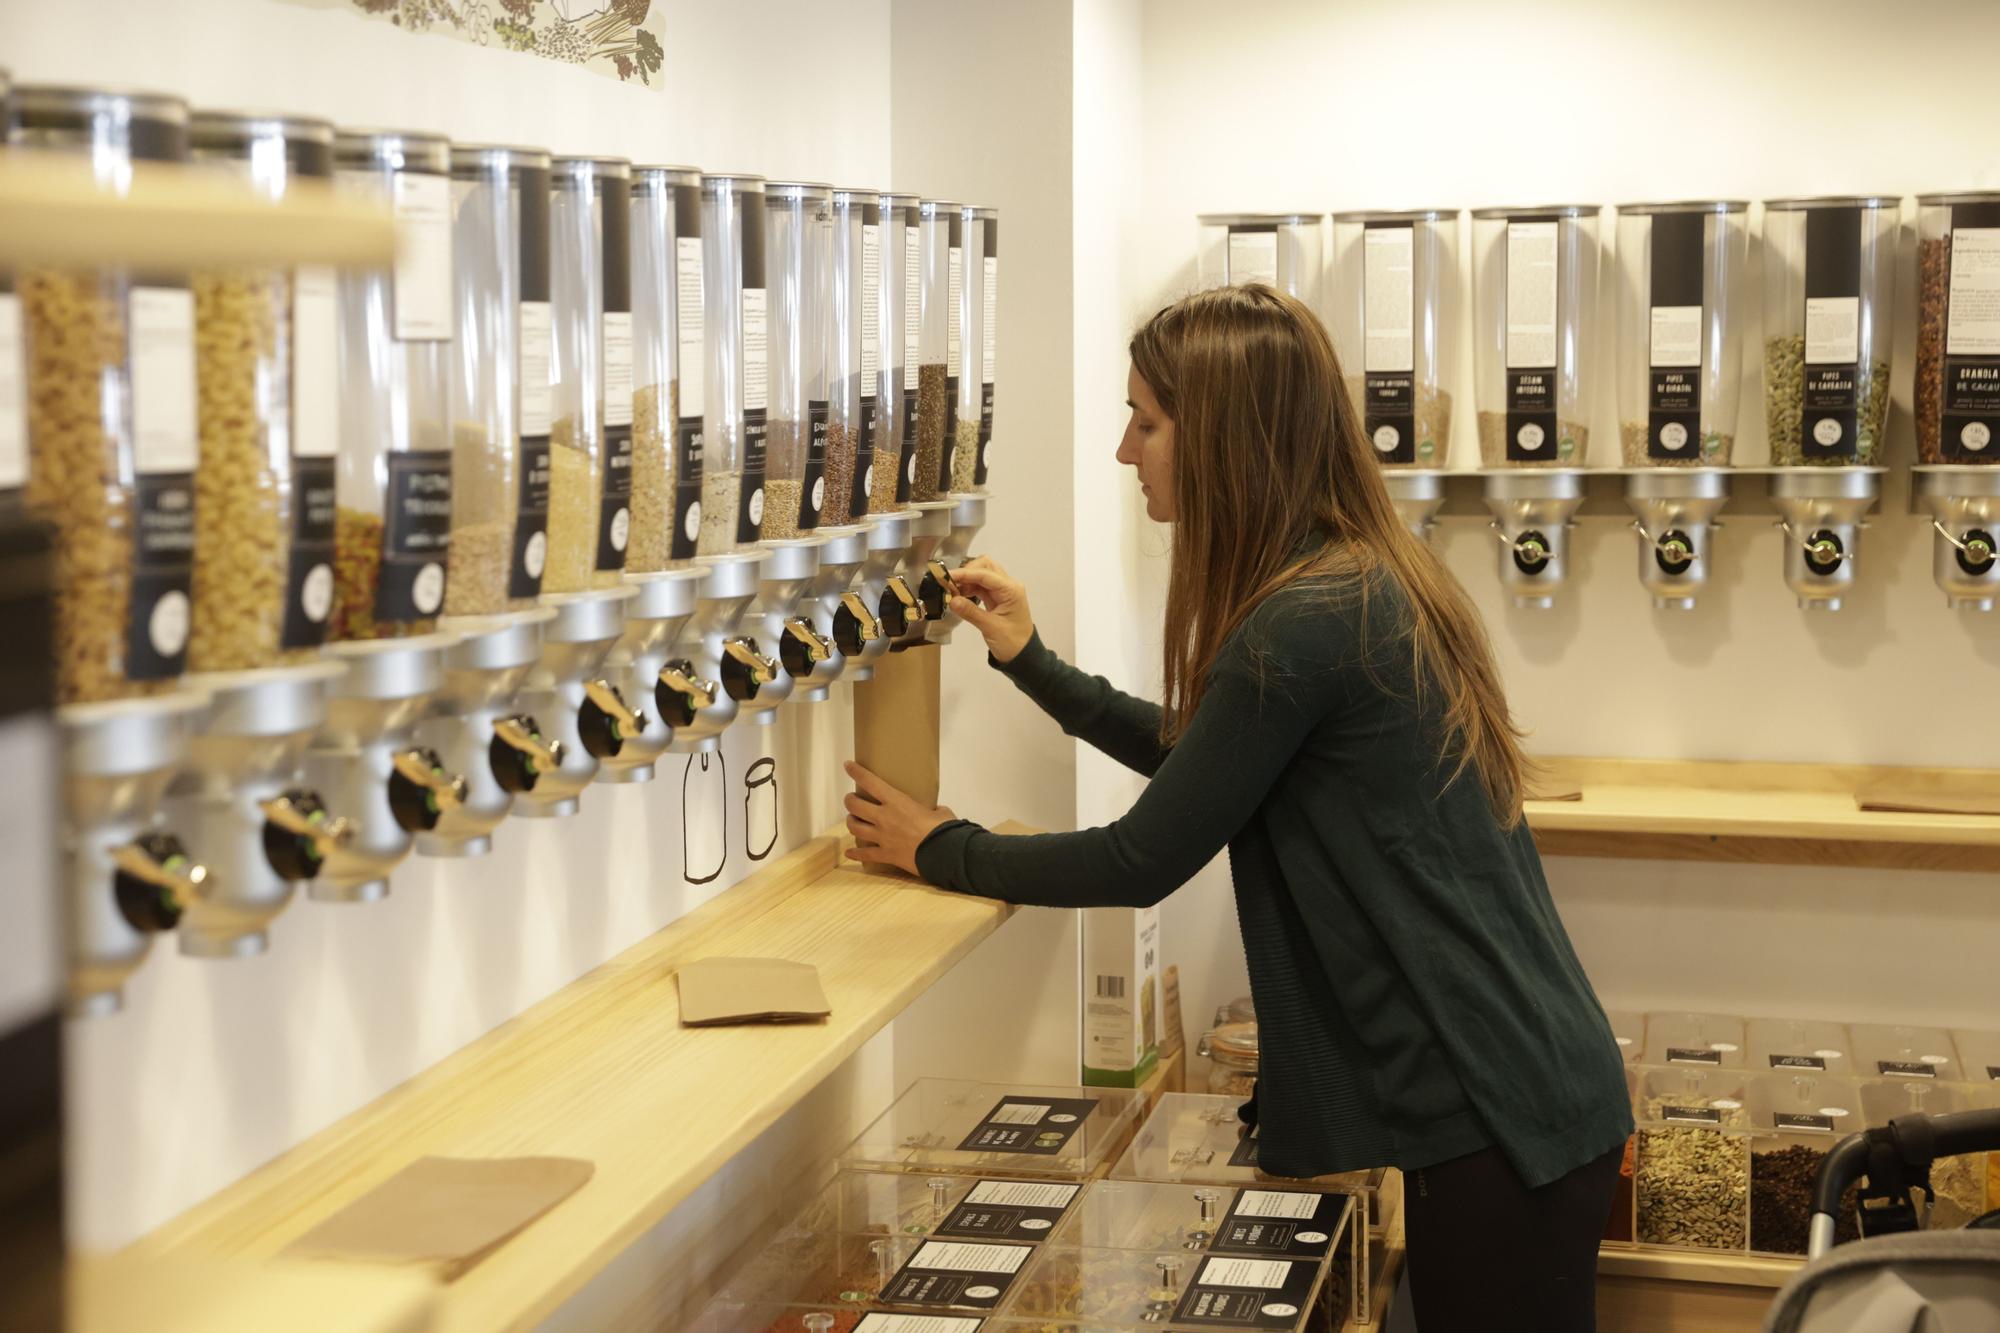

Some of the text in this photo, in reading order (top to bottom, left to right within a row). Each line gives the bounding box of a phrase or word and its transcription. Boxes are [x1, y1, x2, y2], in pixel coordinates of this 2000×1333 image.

[1822, 372, 1840, 380] PIPES
[1960, 368, 1999, 379] GRANOLA
[1666, 374, 1683, 383] PIPES
[1818, 381, 1853, 390] CARBASSA
